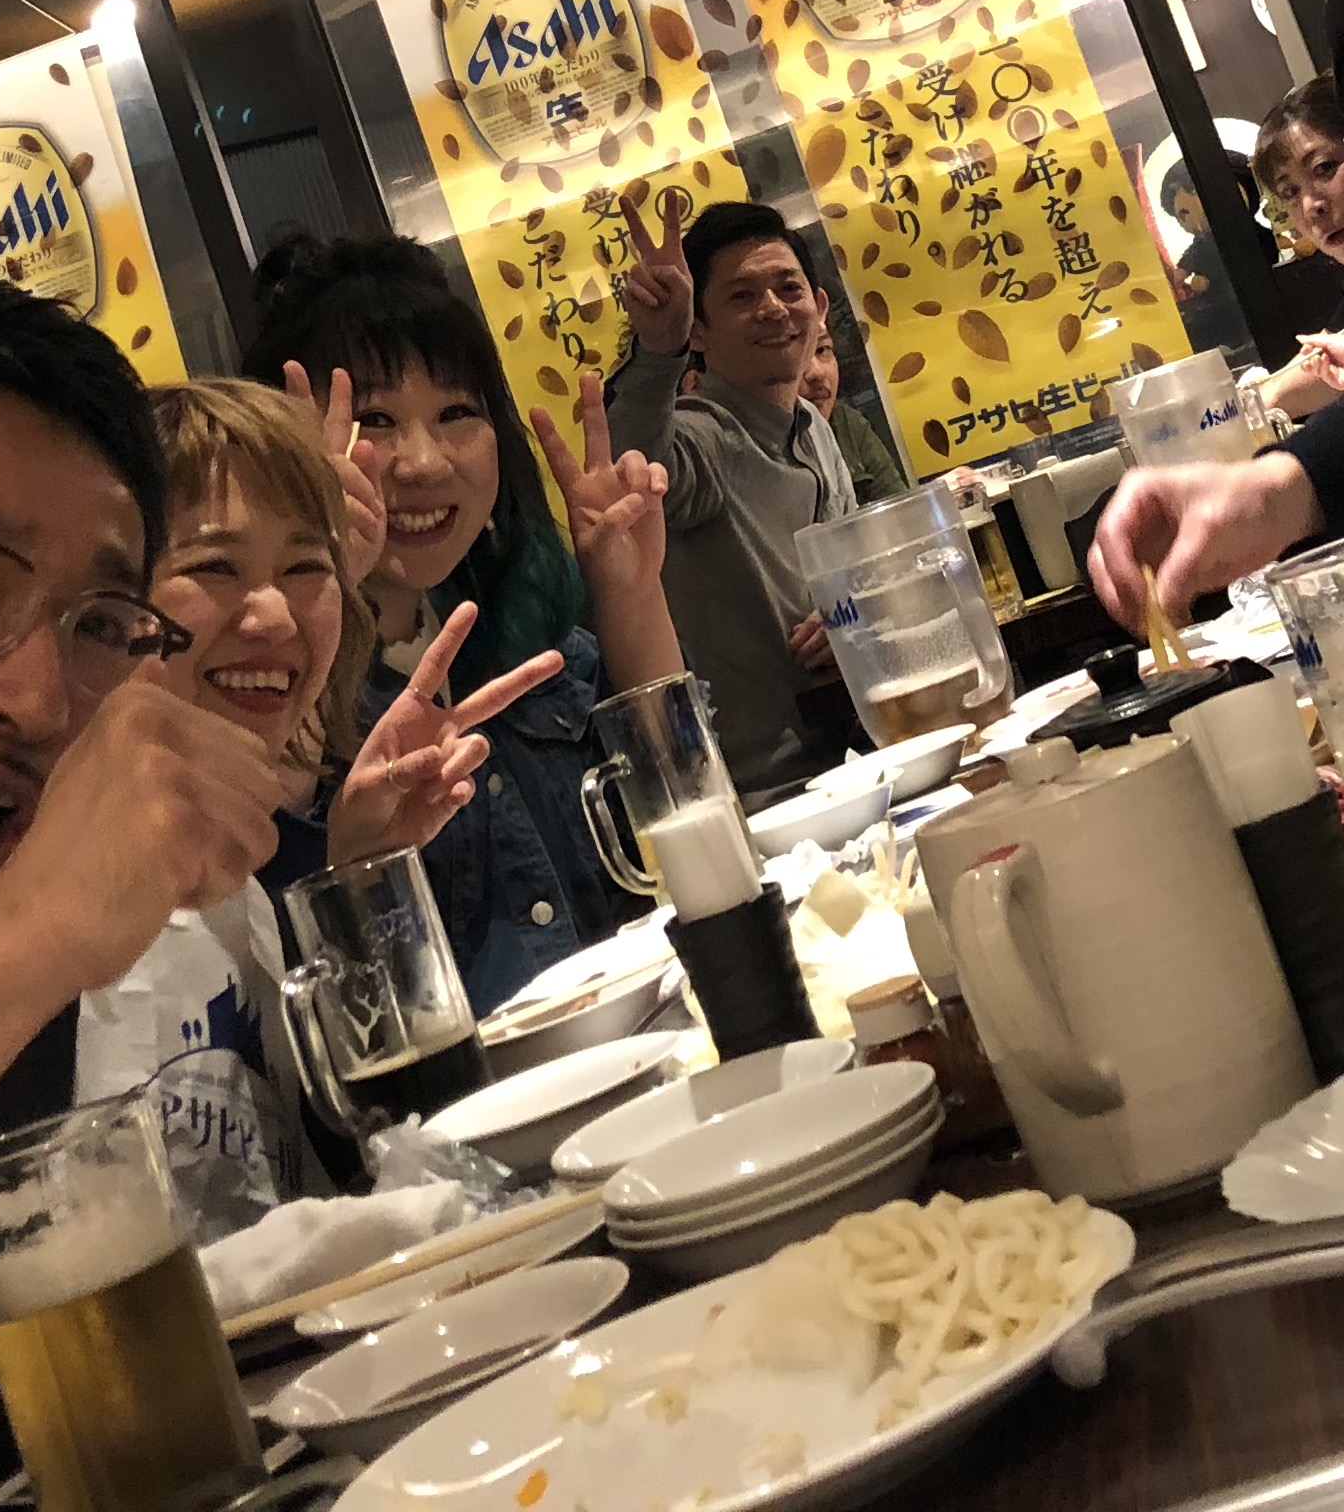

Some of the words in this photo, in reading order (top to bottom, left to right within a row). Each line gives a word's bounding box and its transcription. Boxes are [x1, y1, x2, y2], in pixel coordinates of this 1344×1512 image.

[546, 91, 590, 128] 生
[915, 60, 1030, 304] 受け継がれる
[1199, 398, 1239, 431] Asahi
